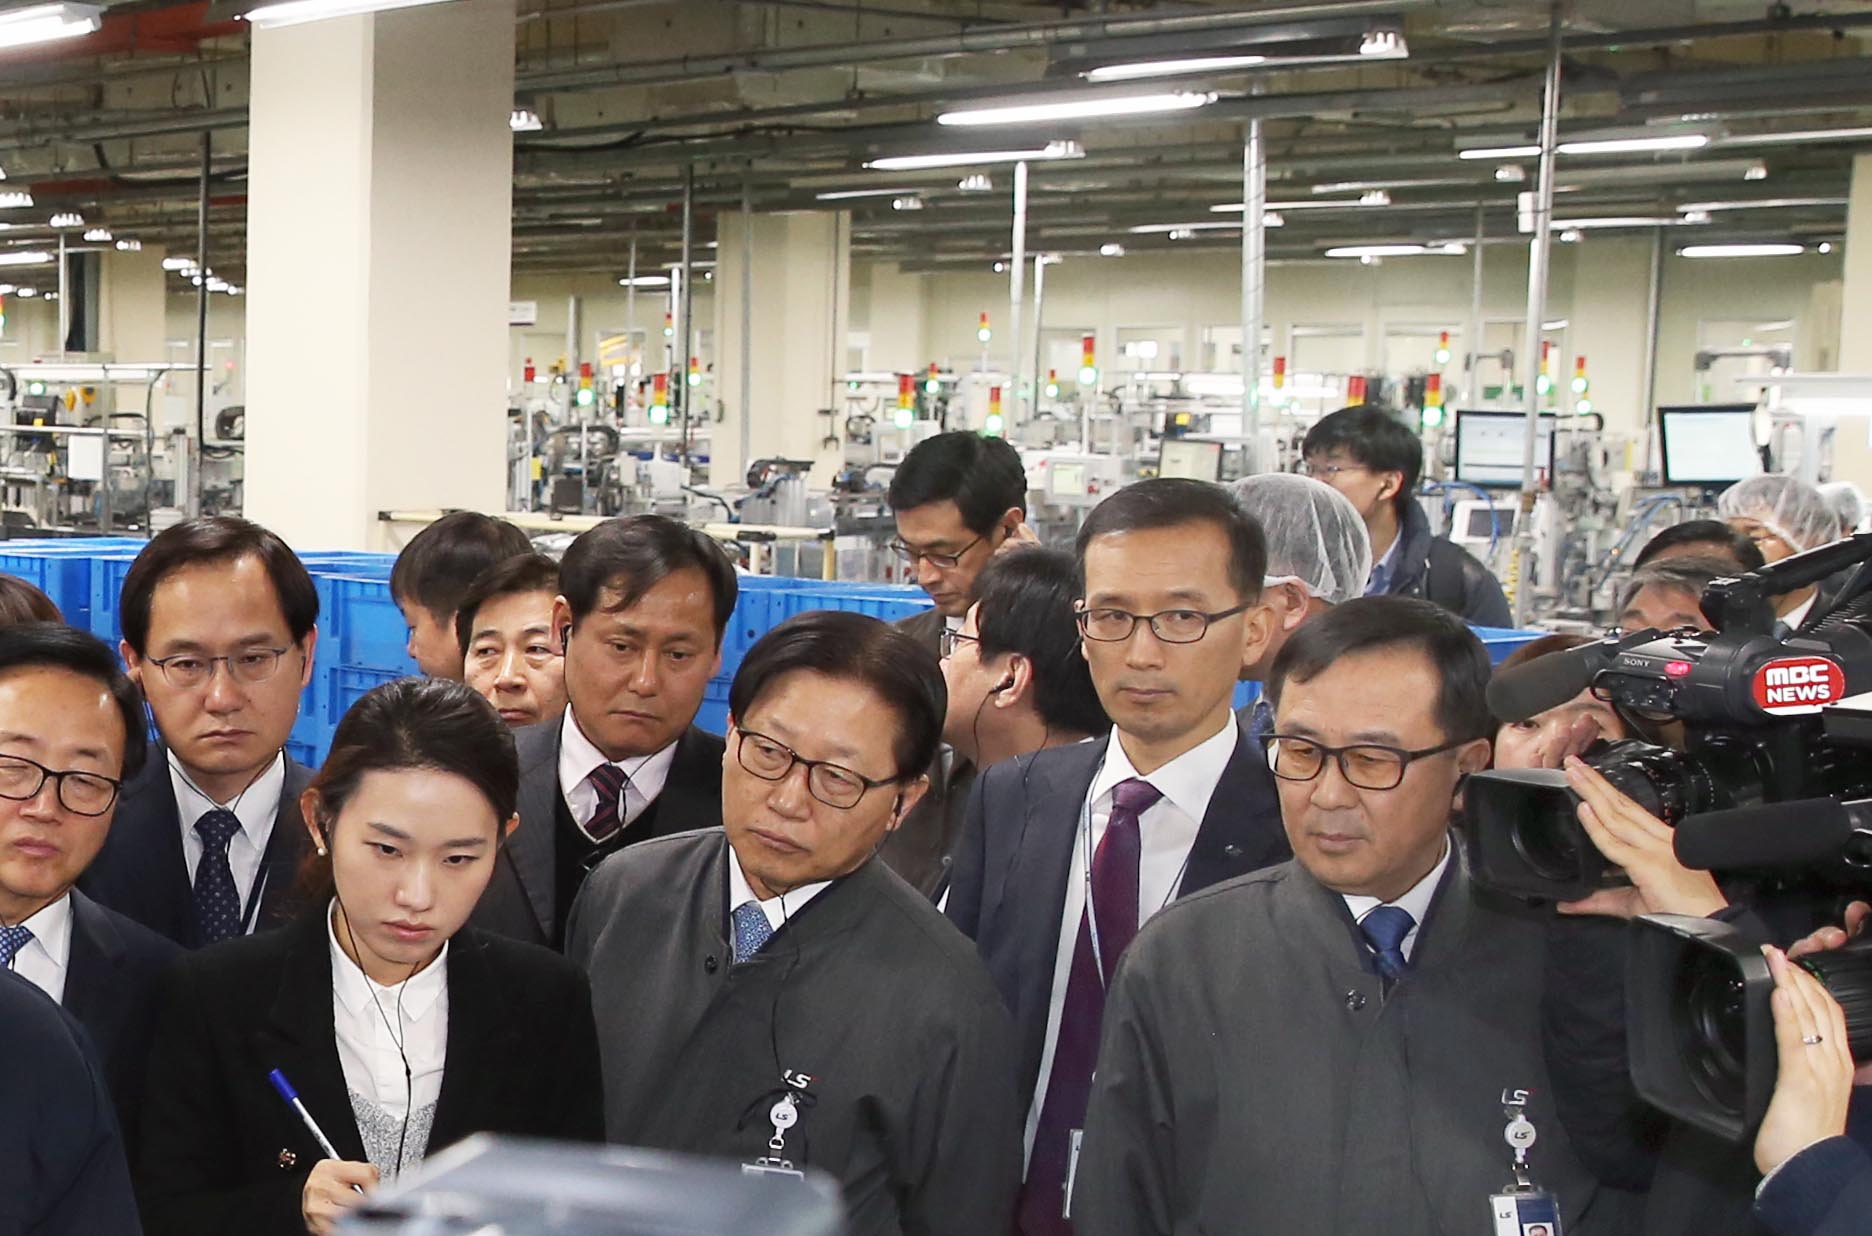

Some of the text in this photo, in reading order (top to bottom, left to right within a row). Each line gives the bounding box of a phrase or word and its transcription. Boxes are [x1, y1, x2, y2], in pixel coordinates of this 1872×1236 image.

[1624, 658, 1650, 668] SONY
[1765, 663, 1829, 686] MBC
[1766, 684, 1831, 704] NEWS
[783, 1069, 812, 1089] LS
[1501, 1088, 1529, 1105] LS
